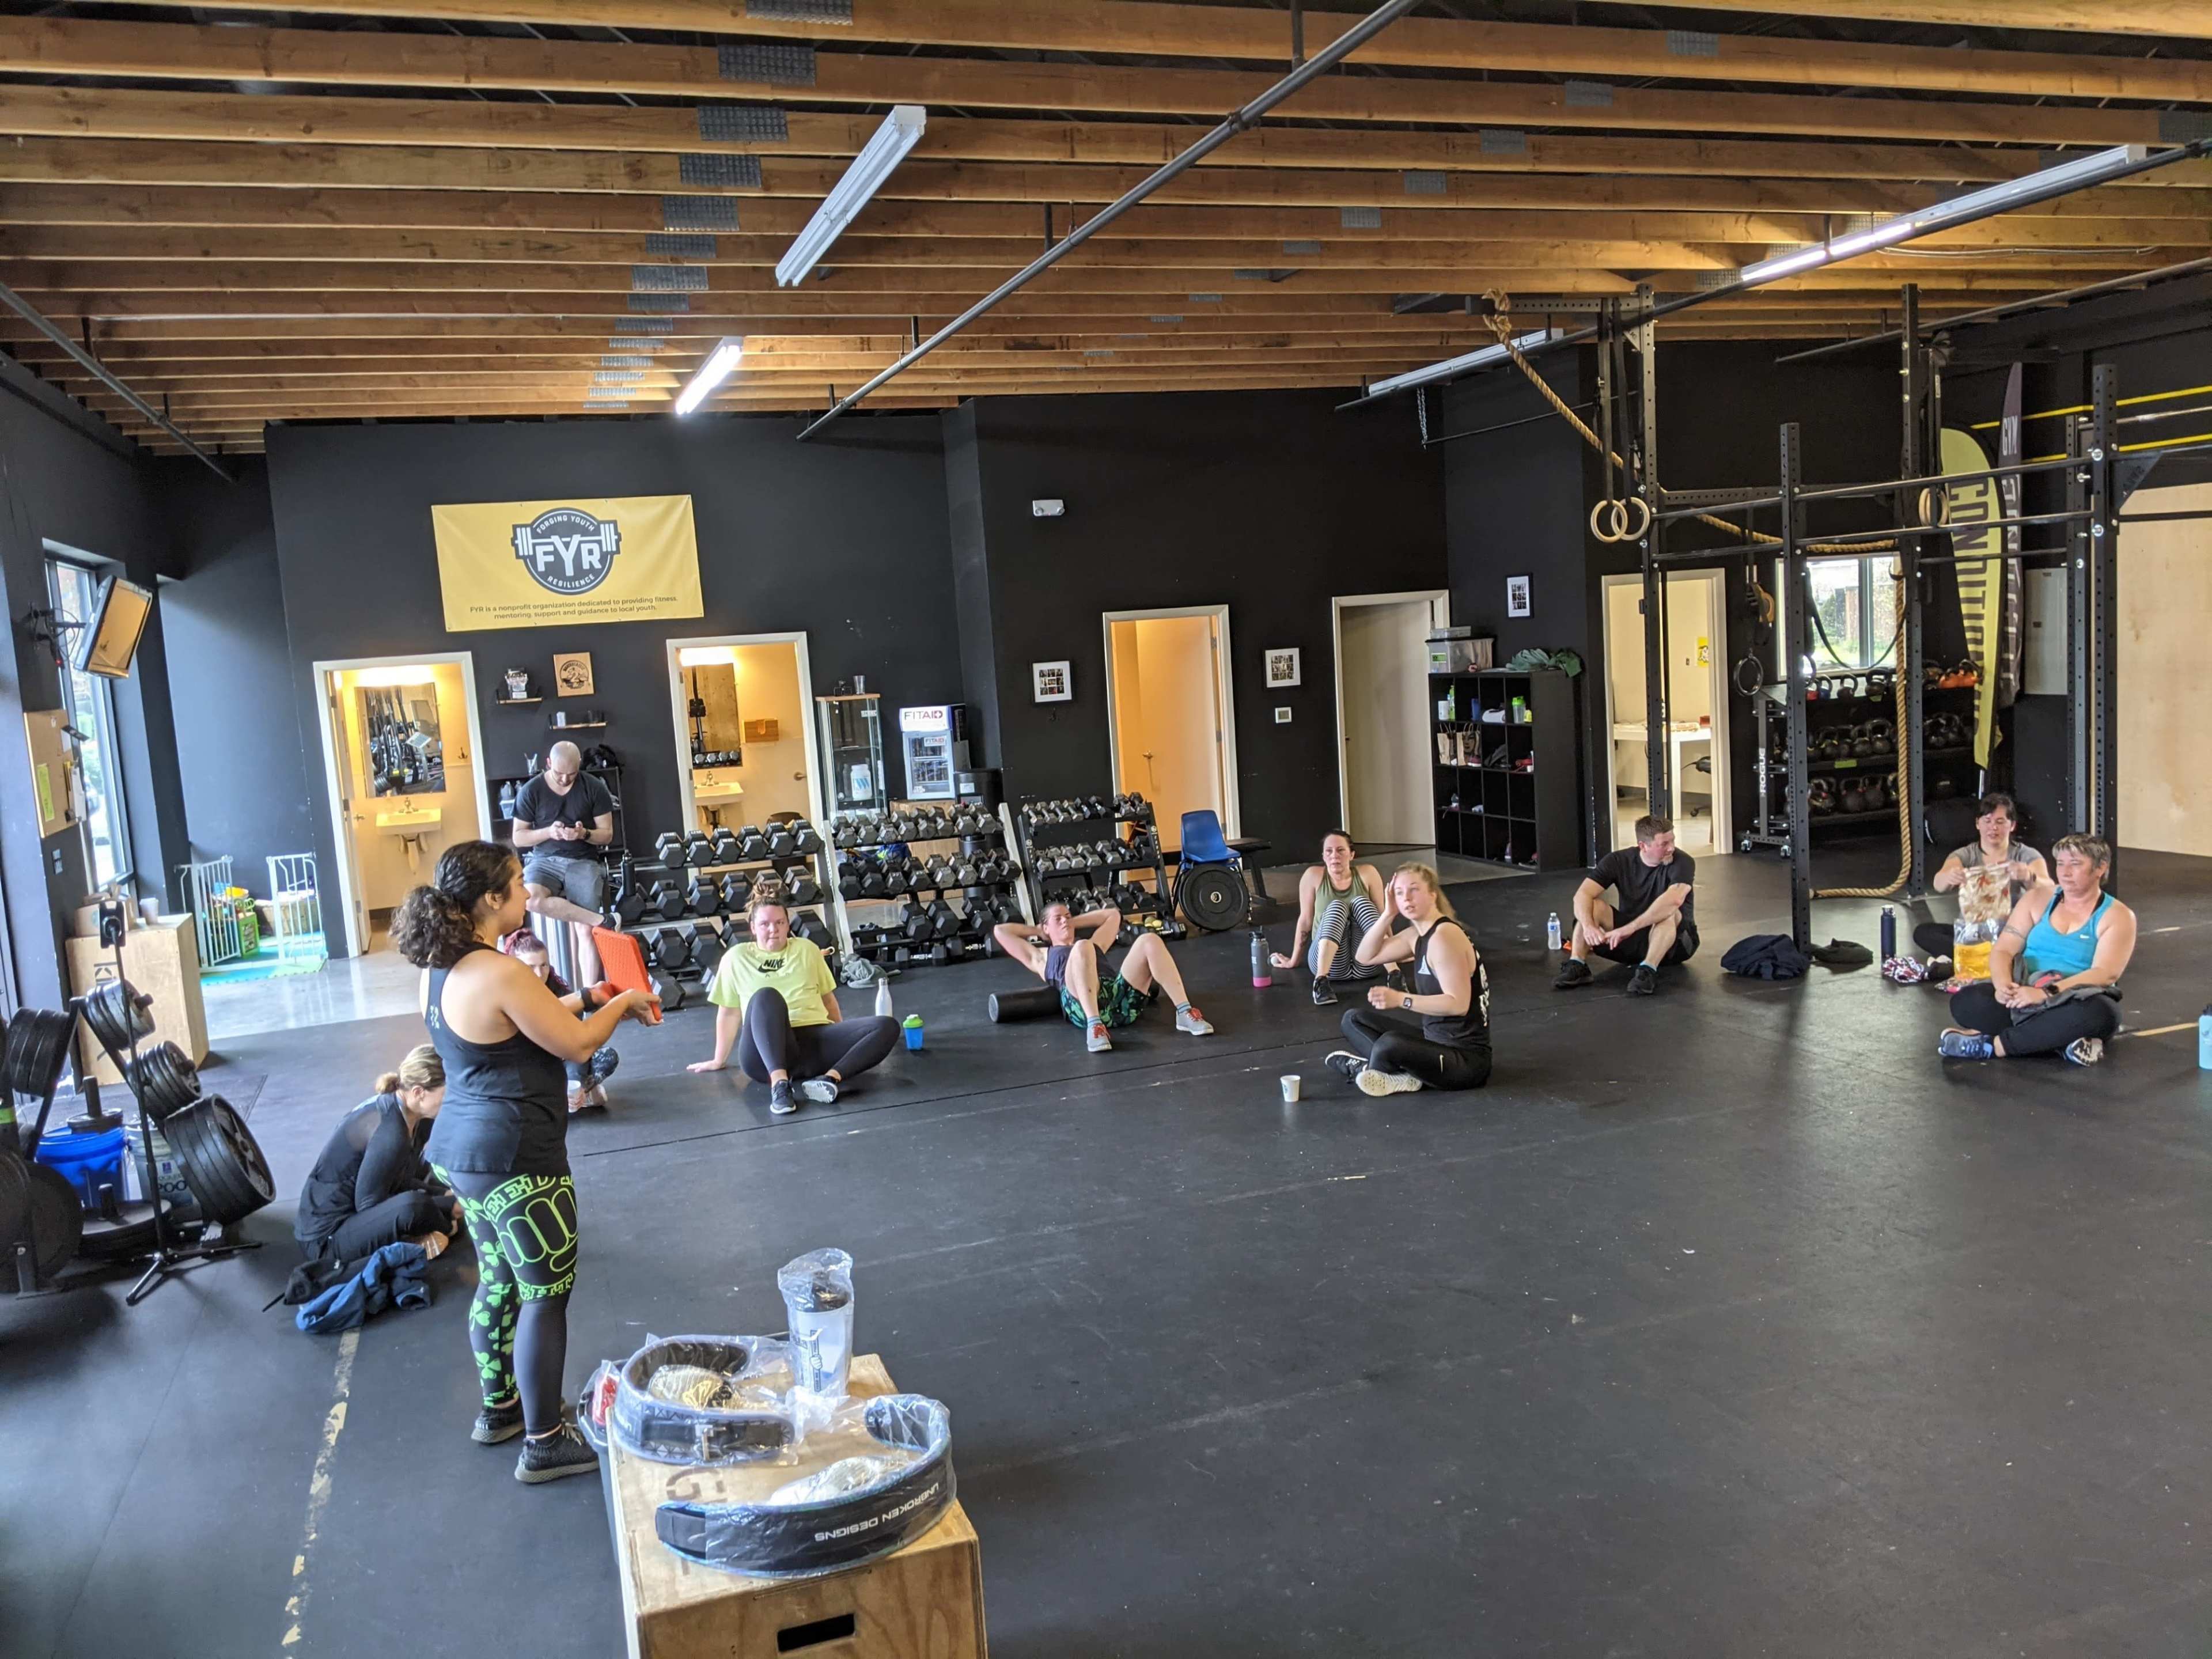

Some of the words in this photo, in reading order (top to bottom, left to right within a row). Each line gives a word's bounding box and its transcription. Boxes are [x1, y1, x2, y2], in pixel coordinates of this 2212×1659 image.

[2002, 415, 2018, 456] GYM
[536, 515, 567, 534] FORGING
[571, 516, 595, 531] YOUTH
[535, 534, 602, 577] FYR
[547, 573, 595, 588] RESILIENCE
[498, 604, 532, 612] nonprofit
[533, 601, 575, 611] organization
[577, 599, 611, 607] dedicated
[622, 596, 653, 605] providing
[577, 607, 609, 616] guidance
[904, 710, 943, 720] FITAID
[763, 957, 785, 968] NIKE
[881, 1482, 940, 1523] UNBROKEN
[814, 1516, 878, 1542] DESIGNS
